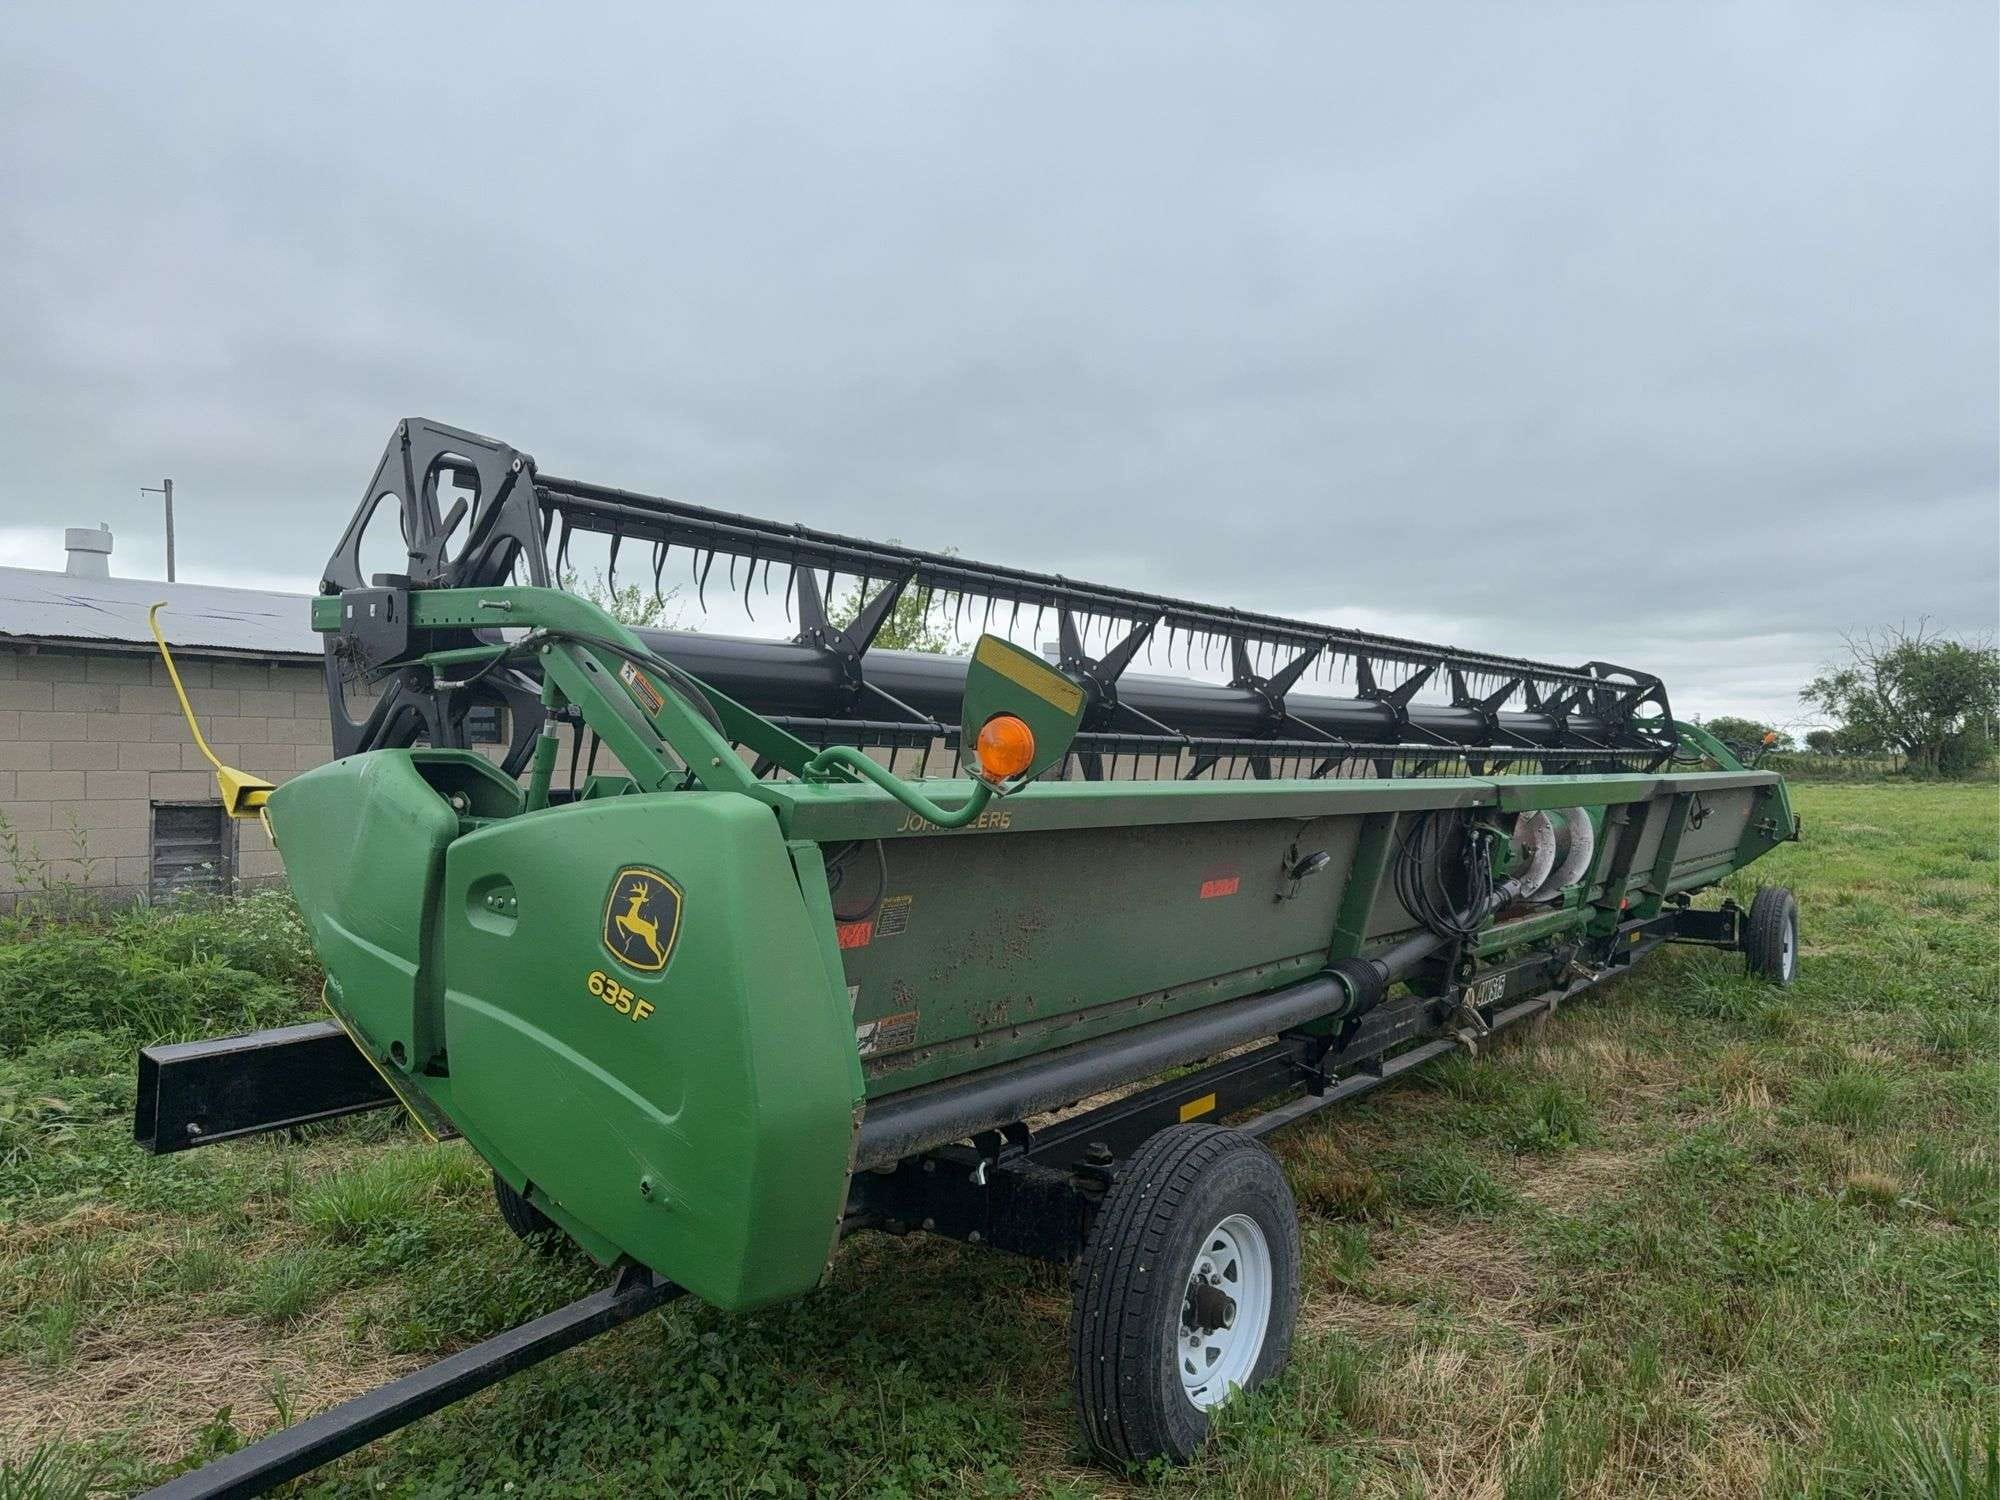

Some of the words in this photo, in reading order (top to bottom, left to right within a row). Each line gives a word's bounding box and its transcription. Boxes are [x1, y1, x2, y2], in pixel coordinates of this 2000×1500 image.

[897, 810, 948, 832] JO
[960, 809, 1013, 830] ERE
[587, 970, 656, 1022] 635F
